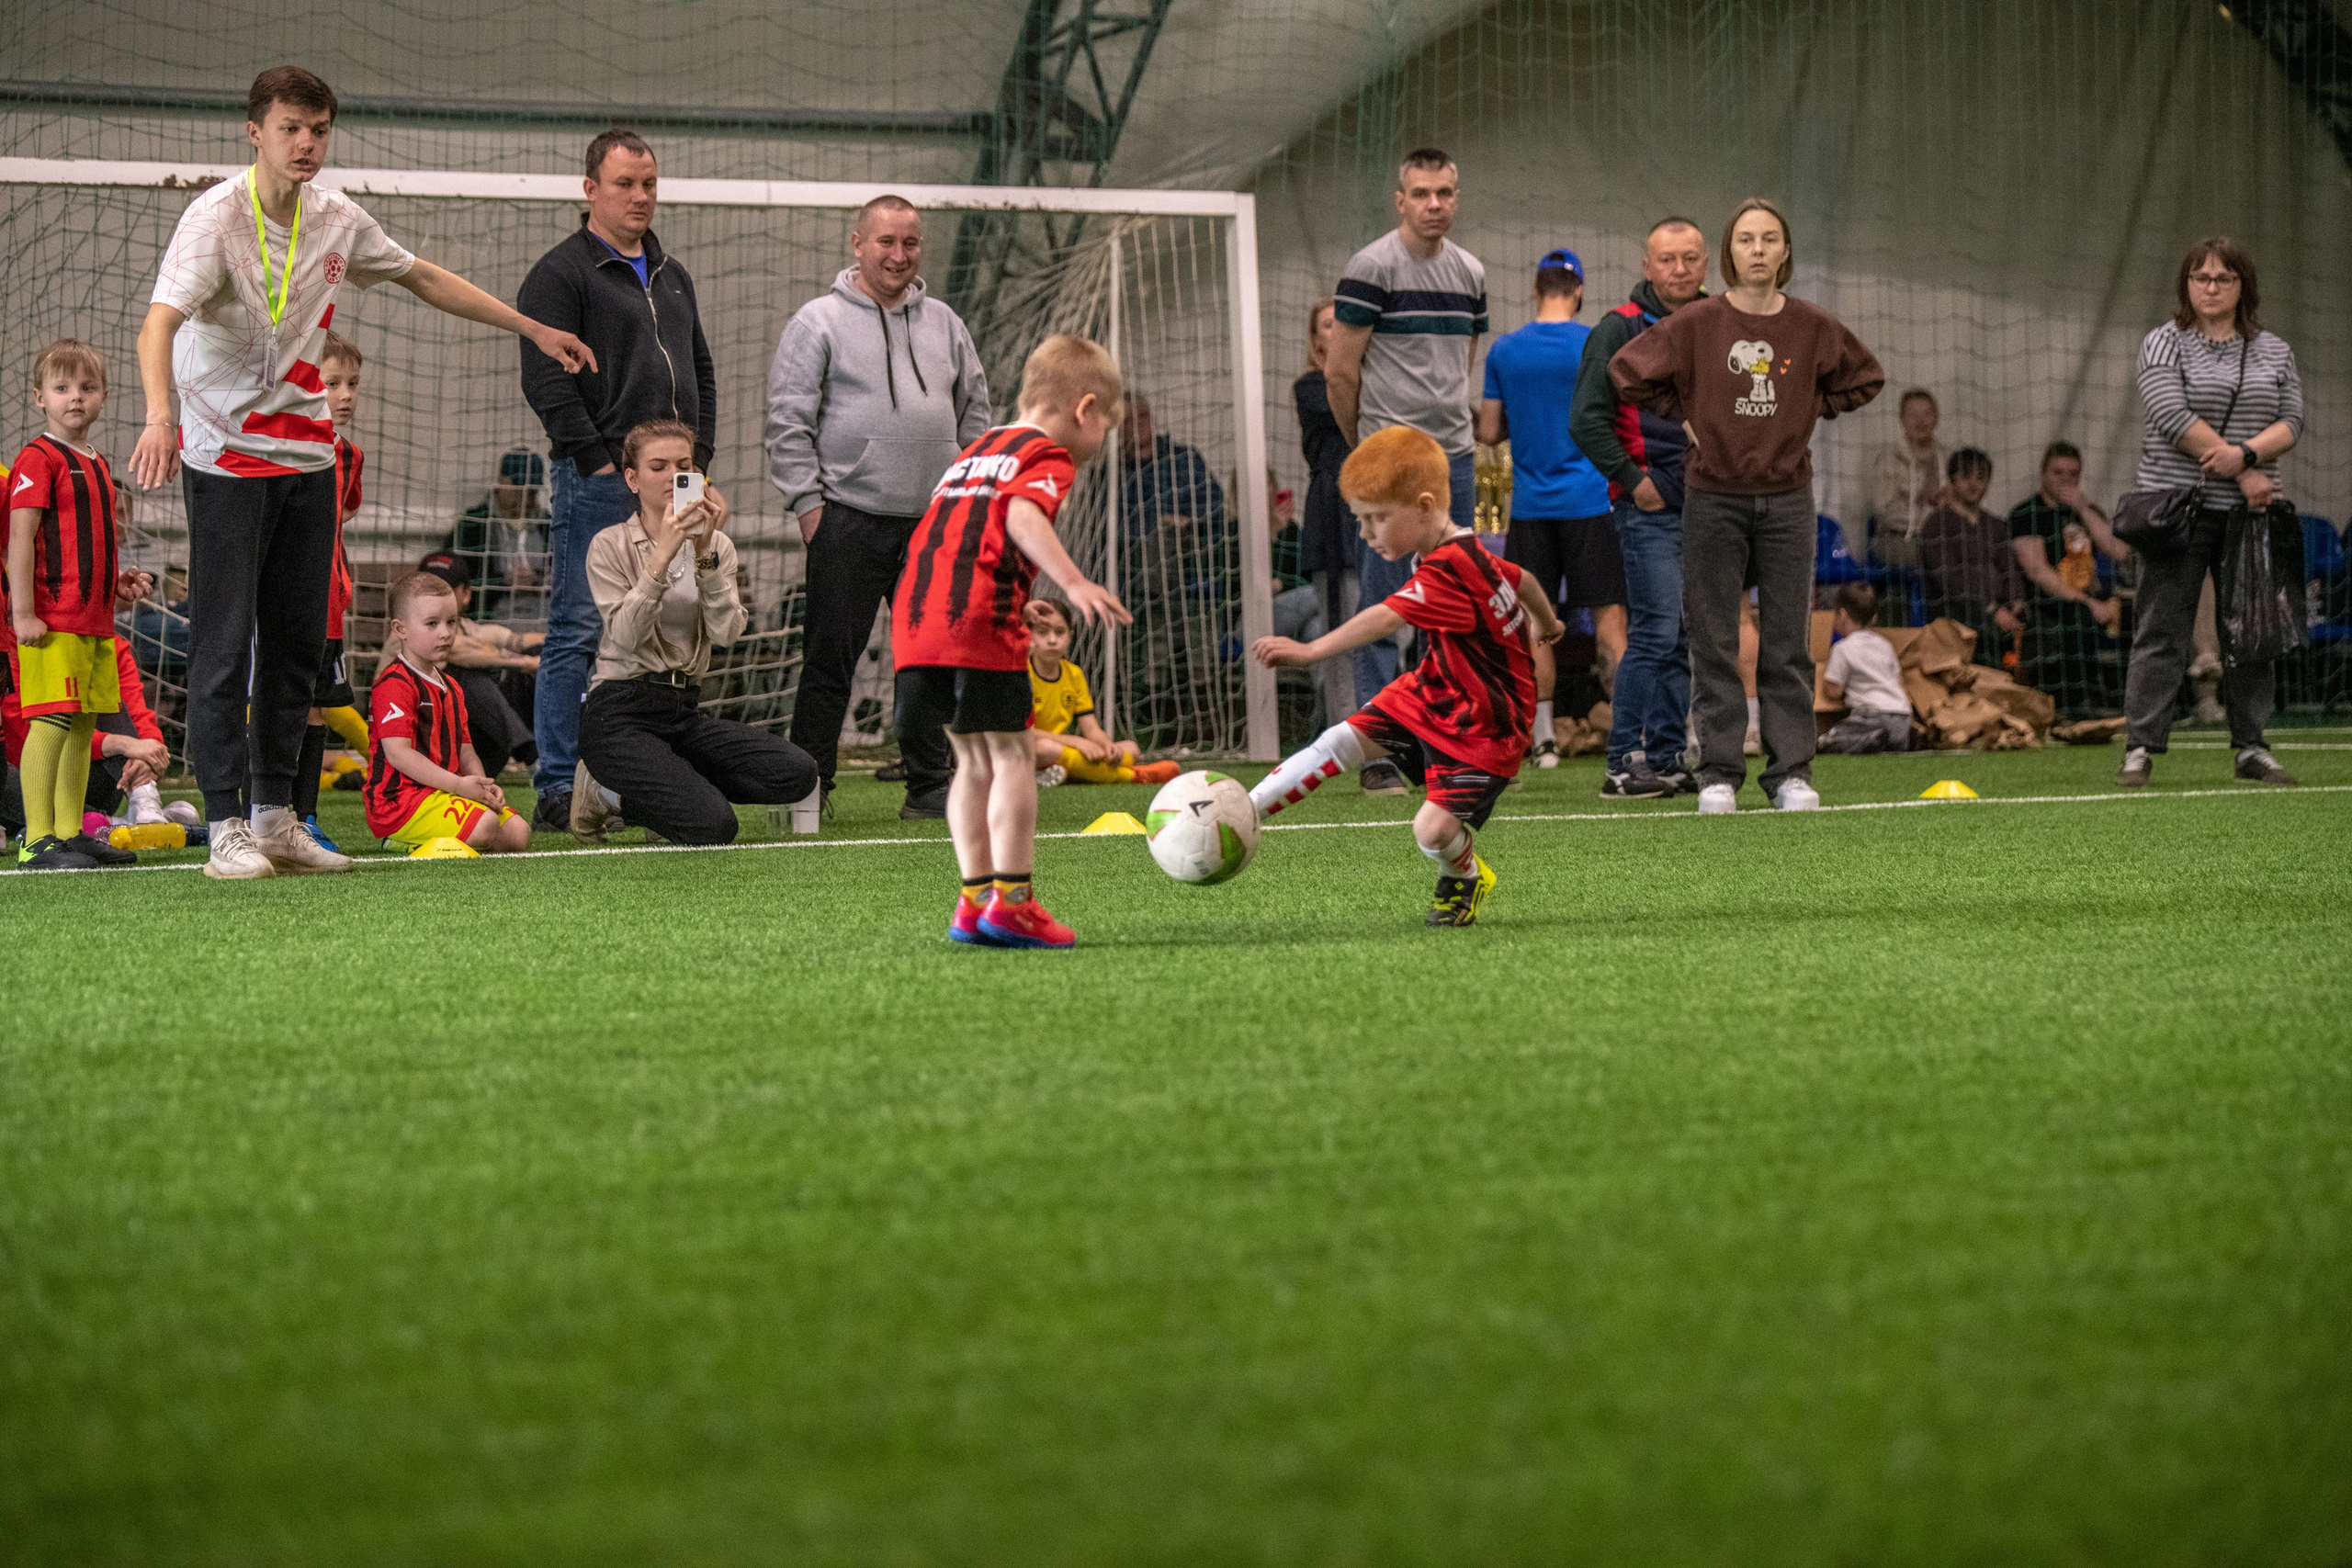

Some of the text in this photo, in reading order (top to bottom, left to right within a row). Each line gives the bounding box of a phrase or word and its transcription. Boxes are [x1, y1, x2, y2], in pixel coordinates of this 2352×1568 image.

[1735, 401, 1778, 417] SNOOPY
[65, 676, 78, 697] 11
[444, 798, 472, 826] 22
